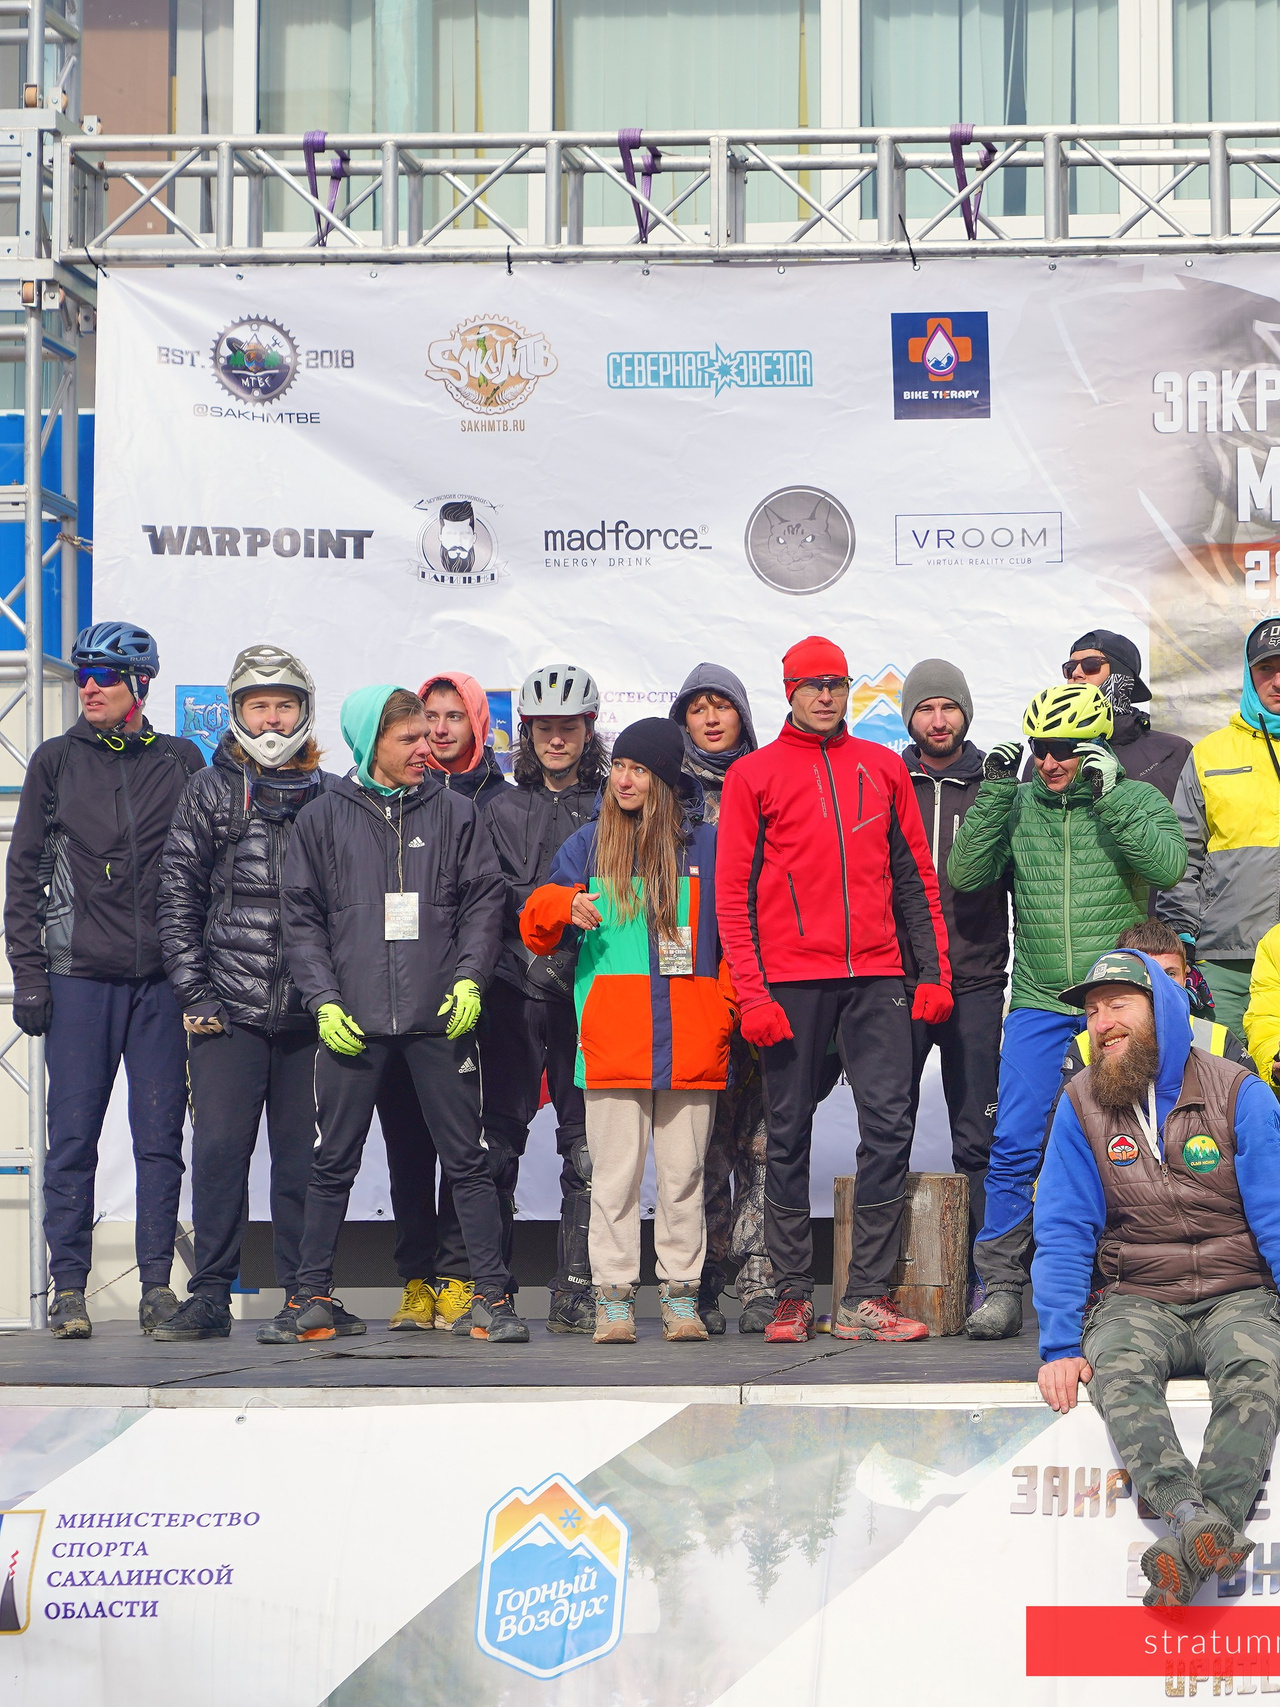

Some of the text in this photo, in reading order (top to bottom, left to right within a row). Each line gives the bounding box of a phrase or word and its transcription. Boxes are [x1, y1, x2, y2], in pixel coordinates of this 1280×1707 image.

[156, 345, 206, 368] EST.
[305, 349, 355, 369] 2018
[608, 350, 812, 388] СЕВЕРНАЯ ЗВЕЗДА
[903, 390, 929, 400] BIKE
[193, 403, 321, 424] @SAKHMTBE
[460, 419, 525, 432] SAKHMTB.RU
[911, 527, 1049, 549] VROOM
[545, 557, 652, 568] ENERGY DRINK
[926, 556, 1032, 566] VIRTUAL REALITY CLUB
[812, 763, 828, 818] VICTORY CODE
[892, 998, 906, 1006] VC
[56, 1511, 261, 1529] МИНИСТЕРСТВО
[52, 1540, 149, 1558] СПОРТА
[46, 1565, 234, 1588] САХАЛИНСКОЙ
[494, 1568, 597, 1616] Горный
[44, 1599, 159, 1620] ОБЛАСТИ
[498, 1591, 609, 1642] Воздух
